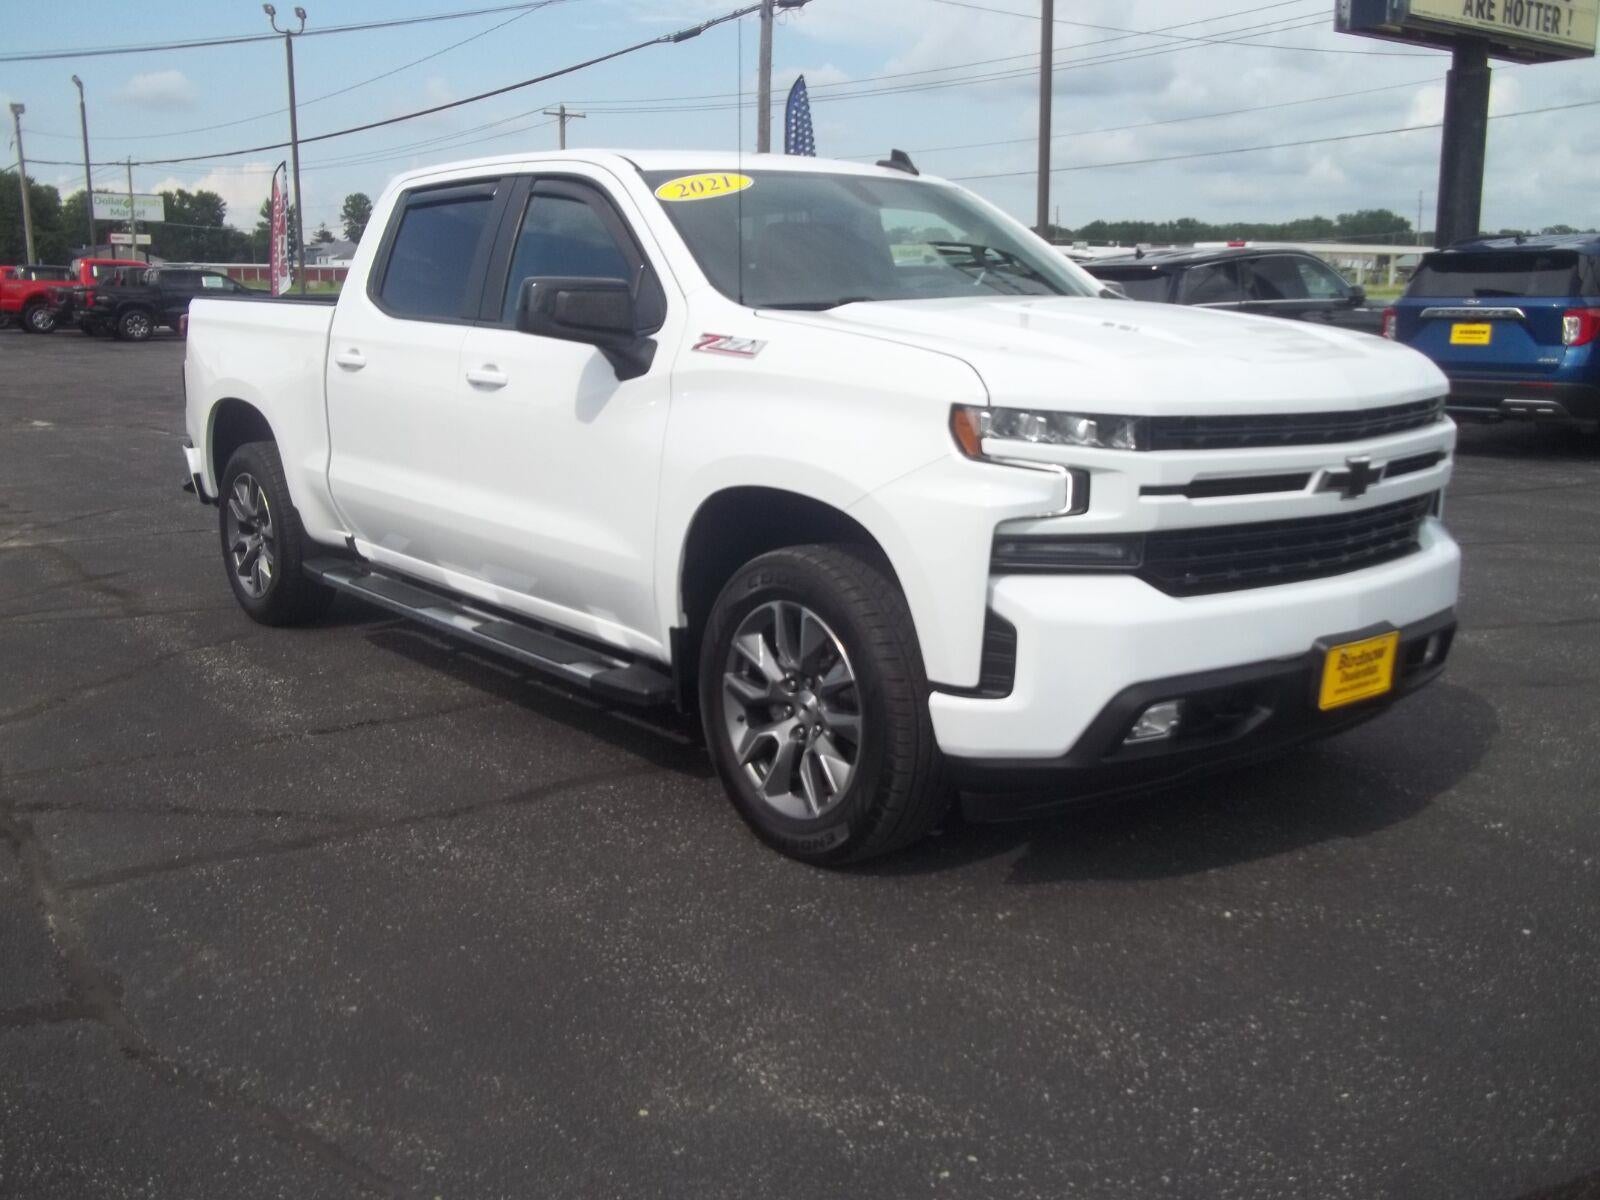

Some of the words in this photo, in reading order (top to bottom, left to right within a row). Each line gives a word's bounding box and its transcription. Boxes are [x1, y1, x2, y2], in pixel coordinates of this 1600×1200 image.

[1462, 0, 1495, 21] ARE
[1503, 0, 1562, 35] HOTTER
[675, 175, 731, 198] 2021
[94, 196, 122, 206] Dollar
